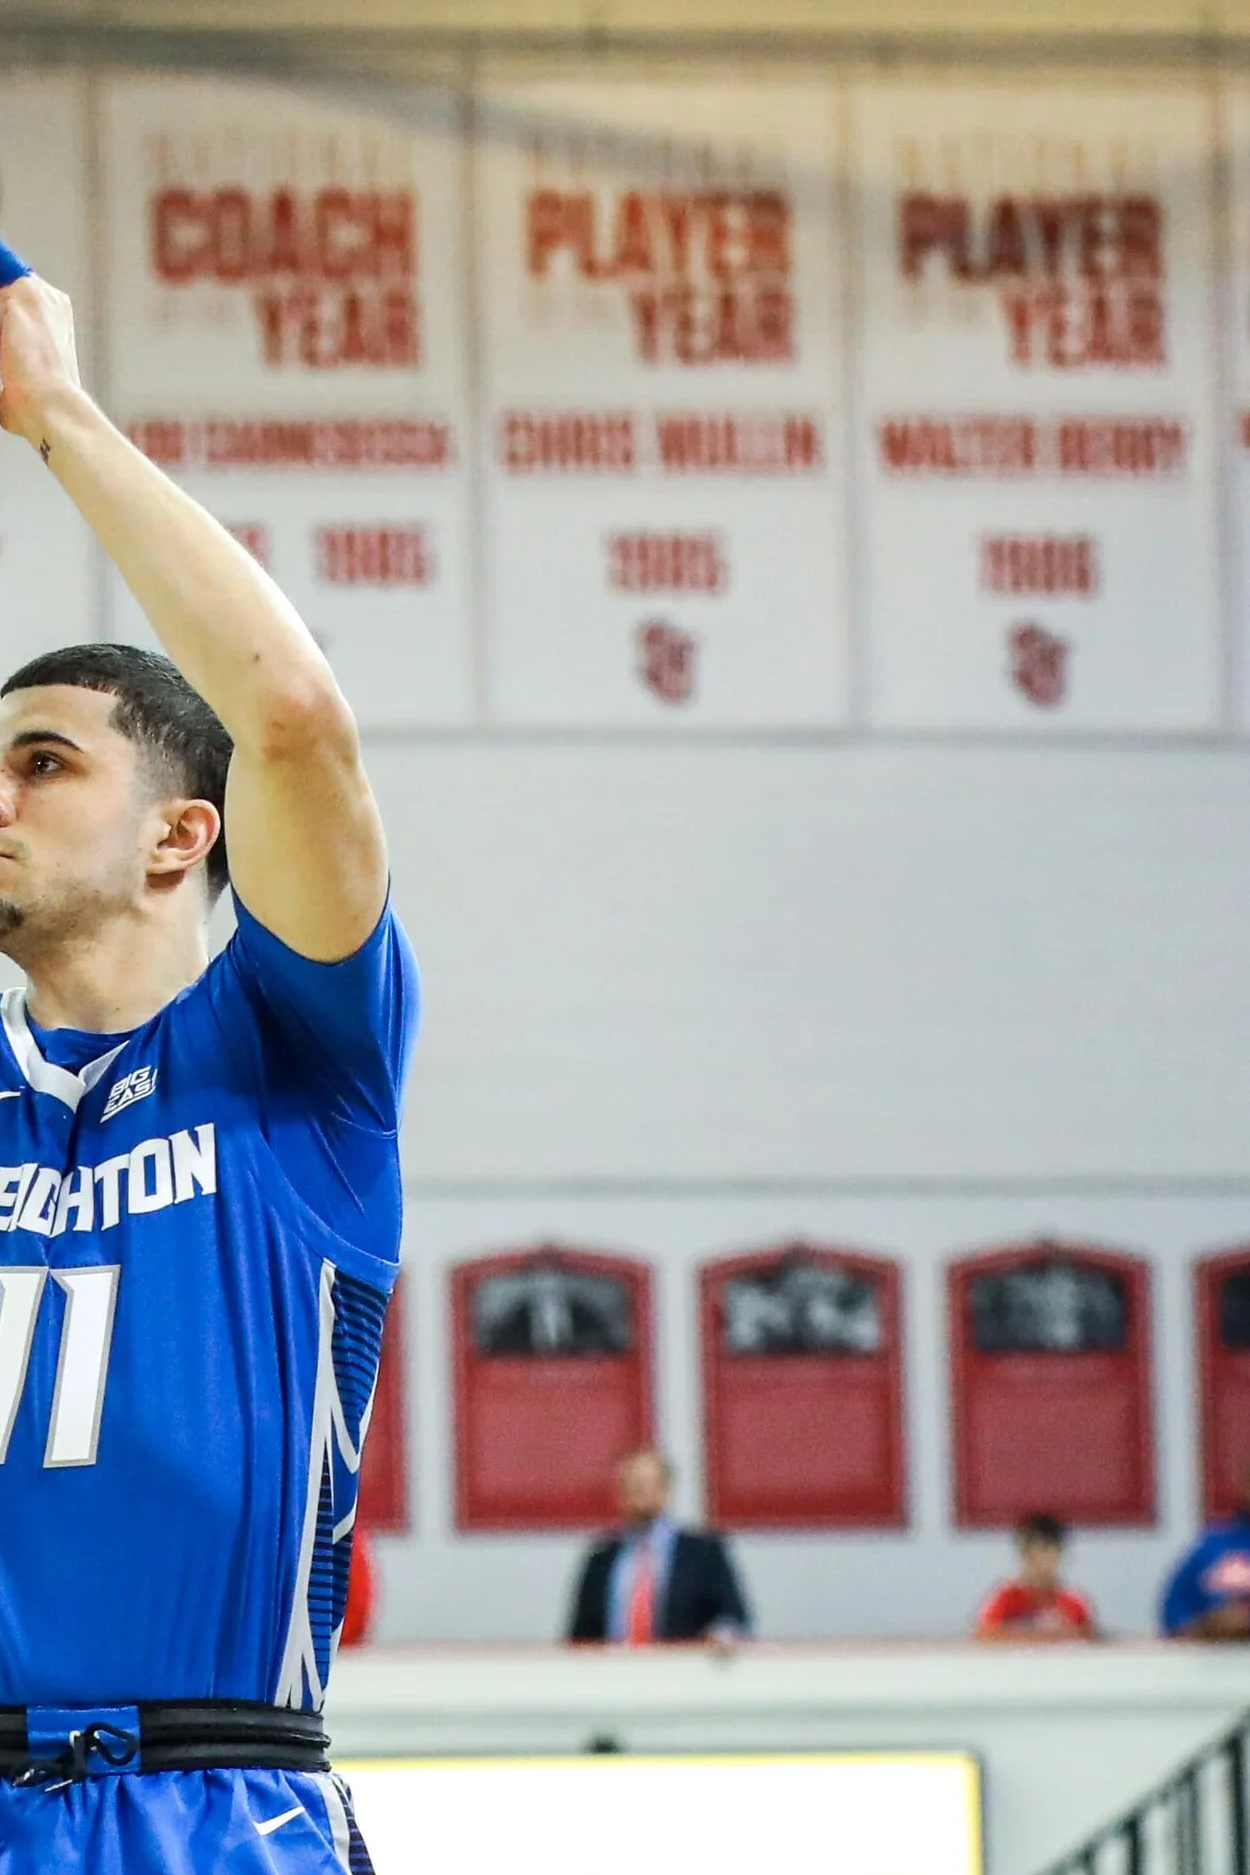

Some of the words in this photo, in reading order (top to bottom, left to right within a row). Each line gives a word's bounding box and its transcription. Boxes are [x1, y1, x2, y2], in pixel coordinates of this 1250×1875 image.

[152, 184, 417, 283] COACH
[524, 186, 792, 282] PLAYER
[897, 188, 1166, 284] PLAYER
[255, 290, 420, 367] YEAR
[629, 291, 796, 365] YEAR
[999, 292, 1167, 367] YEAR
[107, 1065, 152, 1101] BIG
